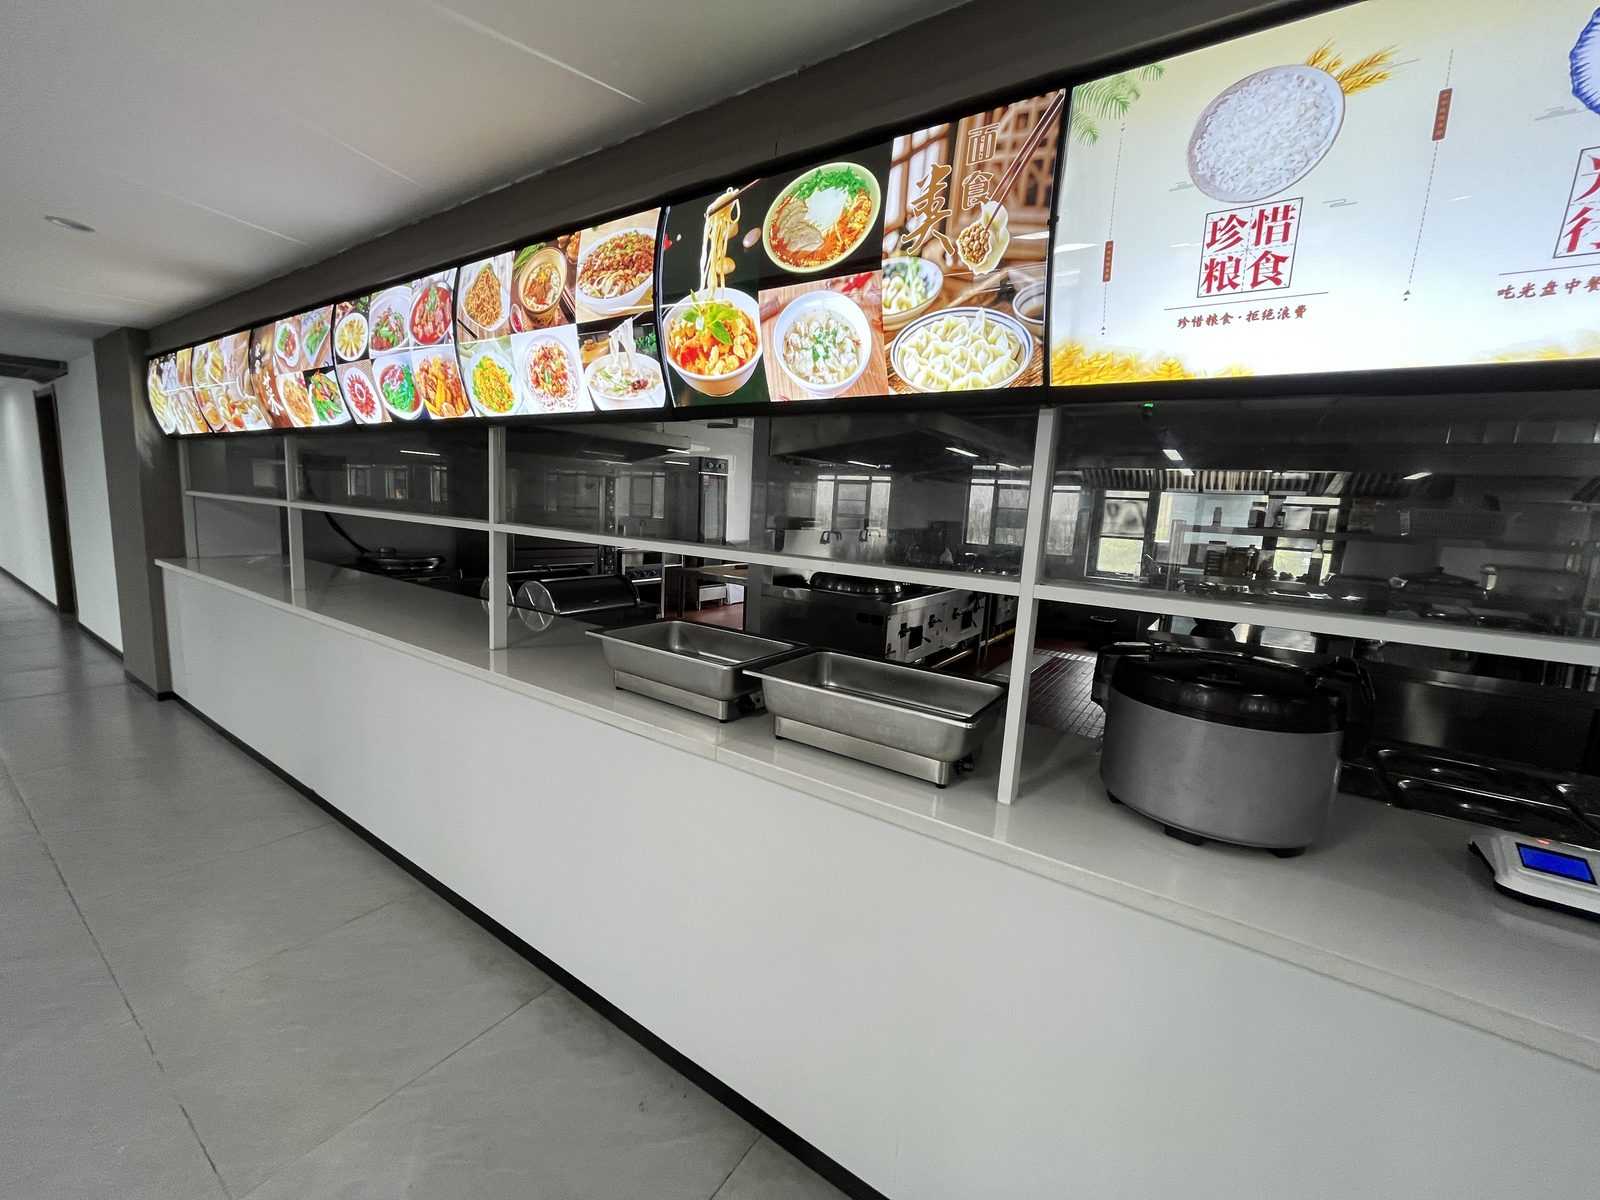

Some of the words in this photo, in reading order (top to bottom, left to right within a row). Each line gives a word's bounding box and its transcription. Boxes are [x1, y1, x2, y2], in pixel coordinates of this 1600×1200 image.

[962, 122, 1001, 211] 面食
[900, 163, 956, 257] 美
[1206, 204, 1296, 253] 珍惜
[1200, 250, 1290, 294] 粮食
